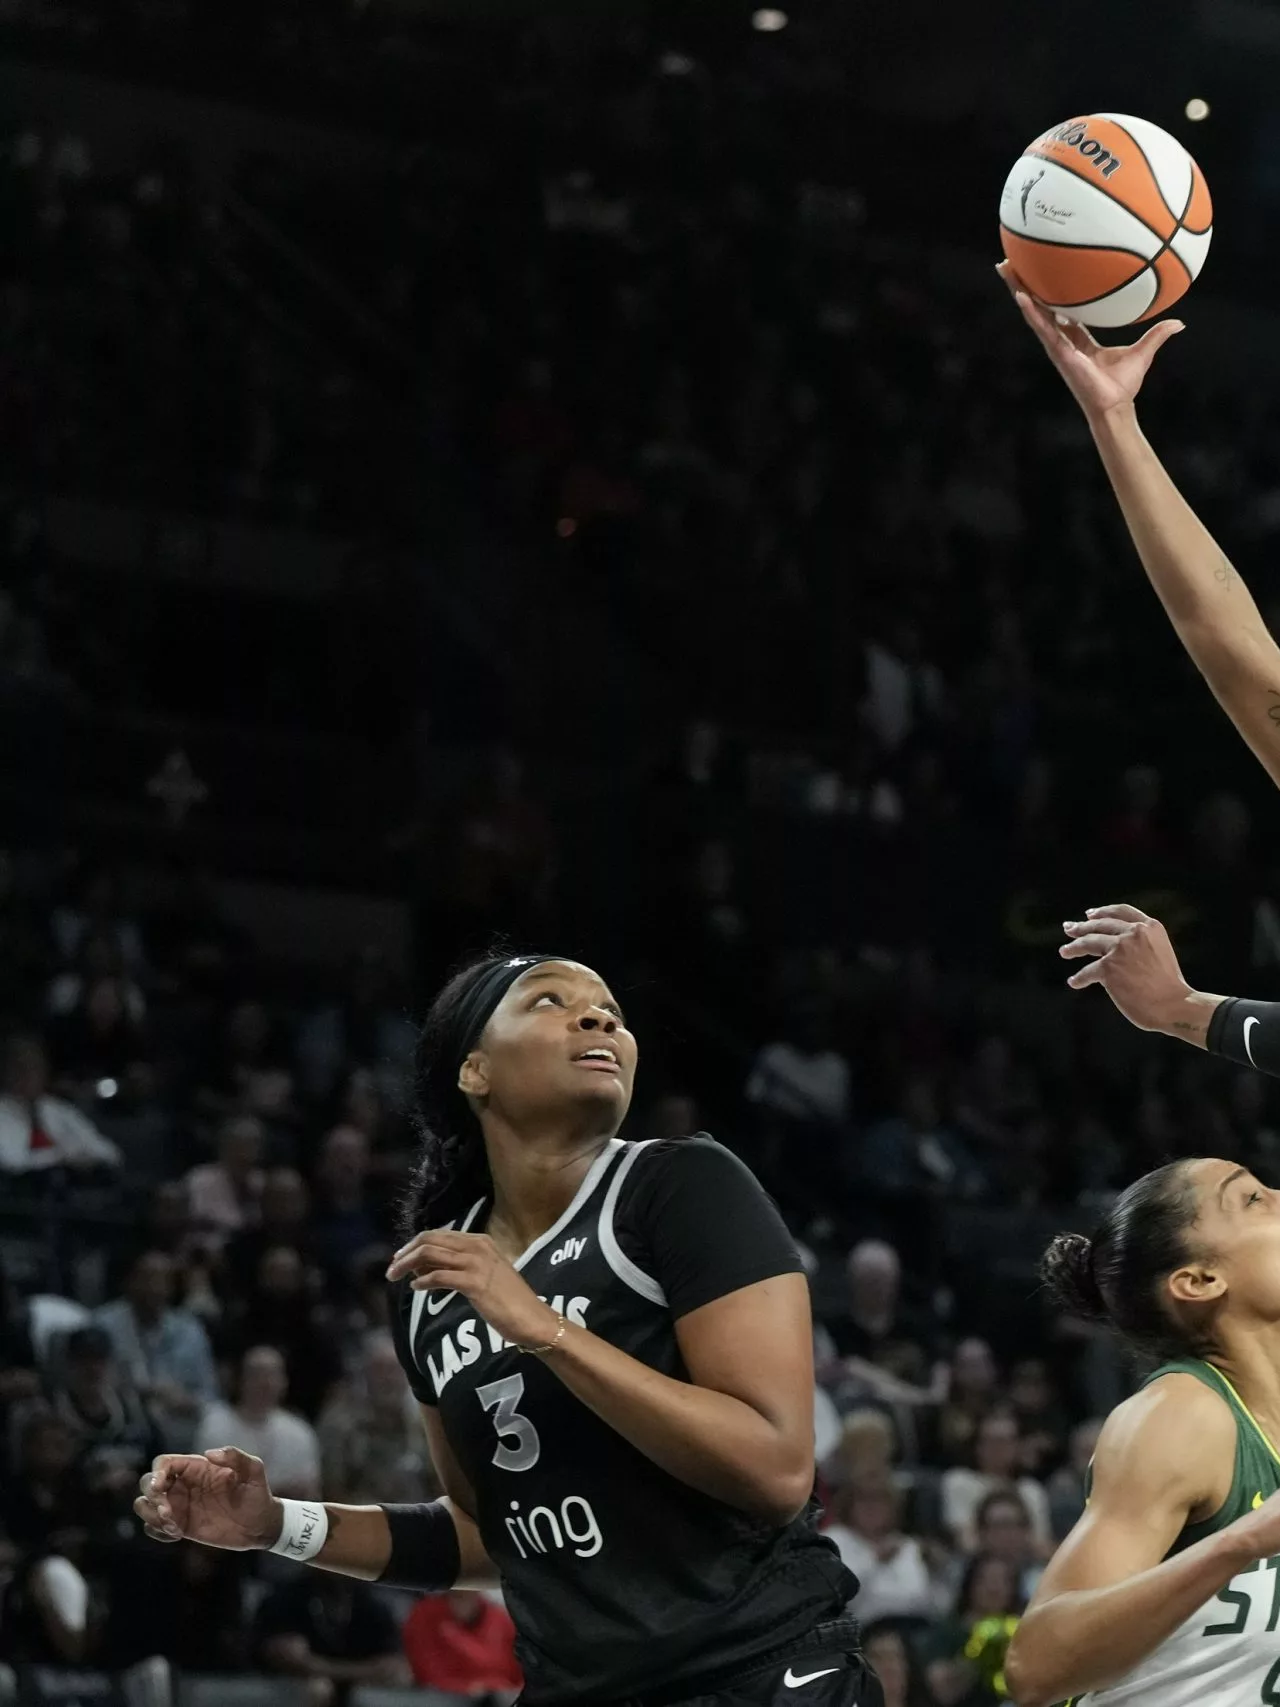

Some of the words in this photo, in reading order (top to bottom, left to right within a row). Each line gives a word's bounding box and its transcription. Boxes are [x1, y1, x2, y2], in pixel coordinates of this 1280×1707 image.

[550, 1237, 588, 1266] ally
[426, 1319, 482, 1398] LAS
[475, 1372, 541, 1472] 3
[505, 1495, 603, 1558] ring
